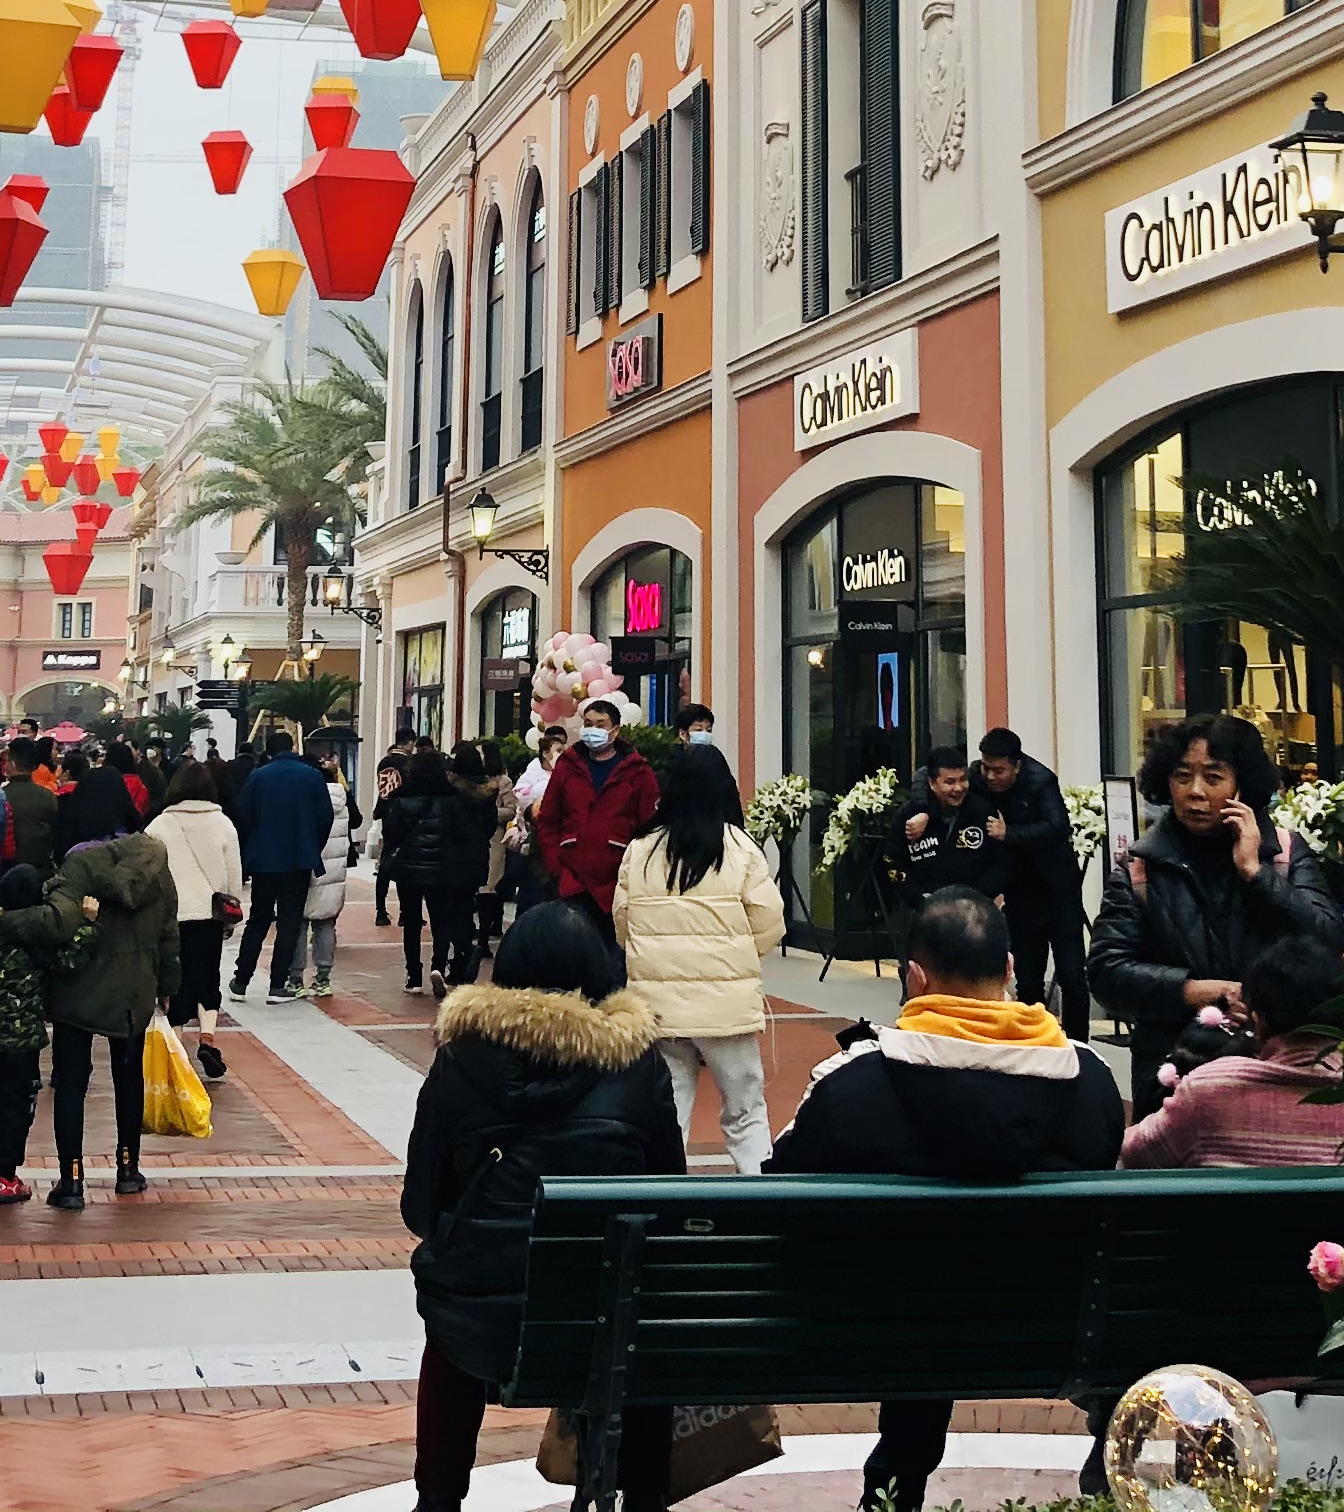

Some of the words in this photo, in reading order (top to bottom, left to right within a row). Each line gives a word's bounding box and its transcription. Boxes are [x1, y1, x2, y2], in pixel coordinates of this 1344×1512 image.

[1121, 191, 1216, 282] Calvin
[1221, 153, 1303, 246] Klein
[800, 373, 850, 434] Calvin
[852, 356, 894, 416] Klein
[842, 554, 877, 592] Calvin
[878, 549, 906, 585] Klein
[848, 621, 873, 630] Calvin
